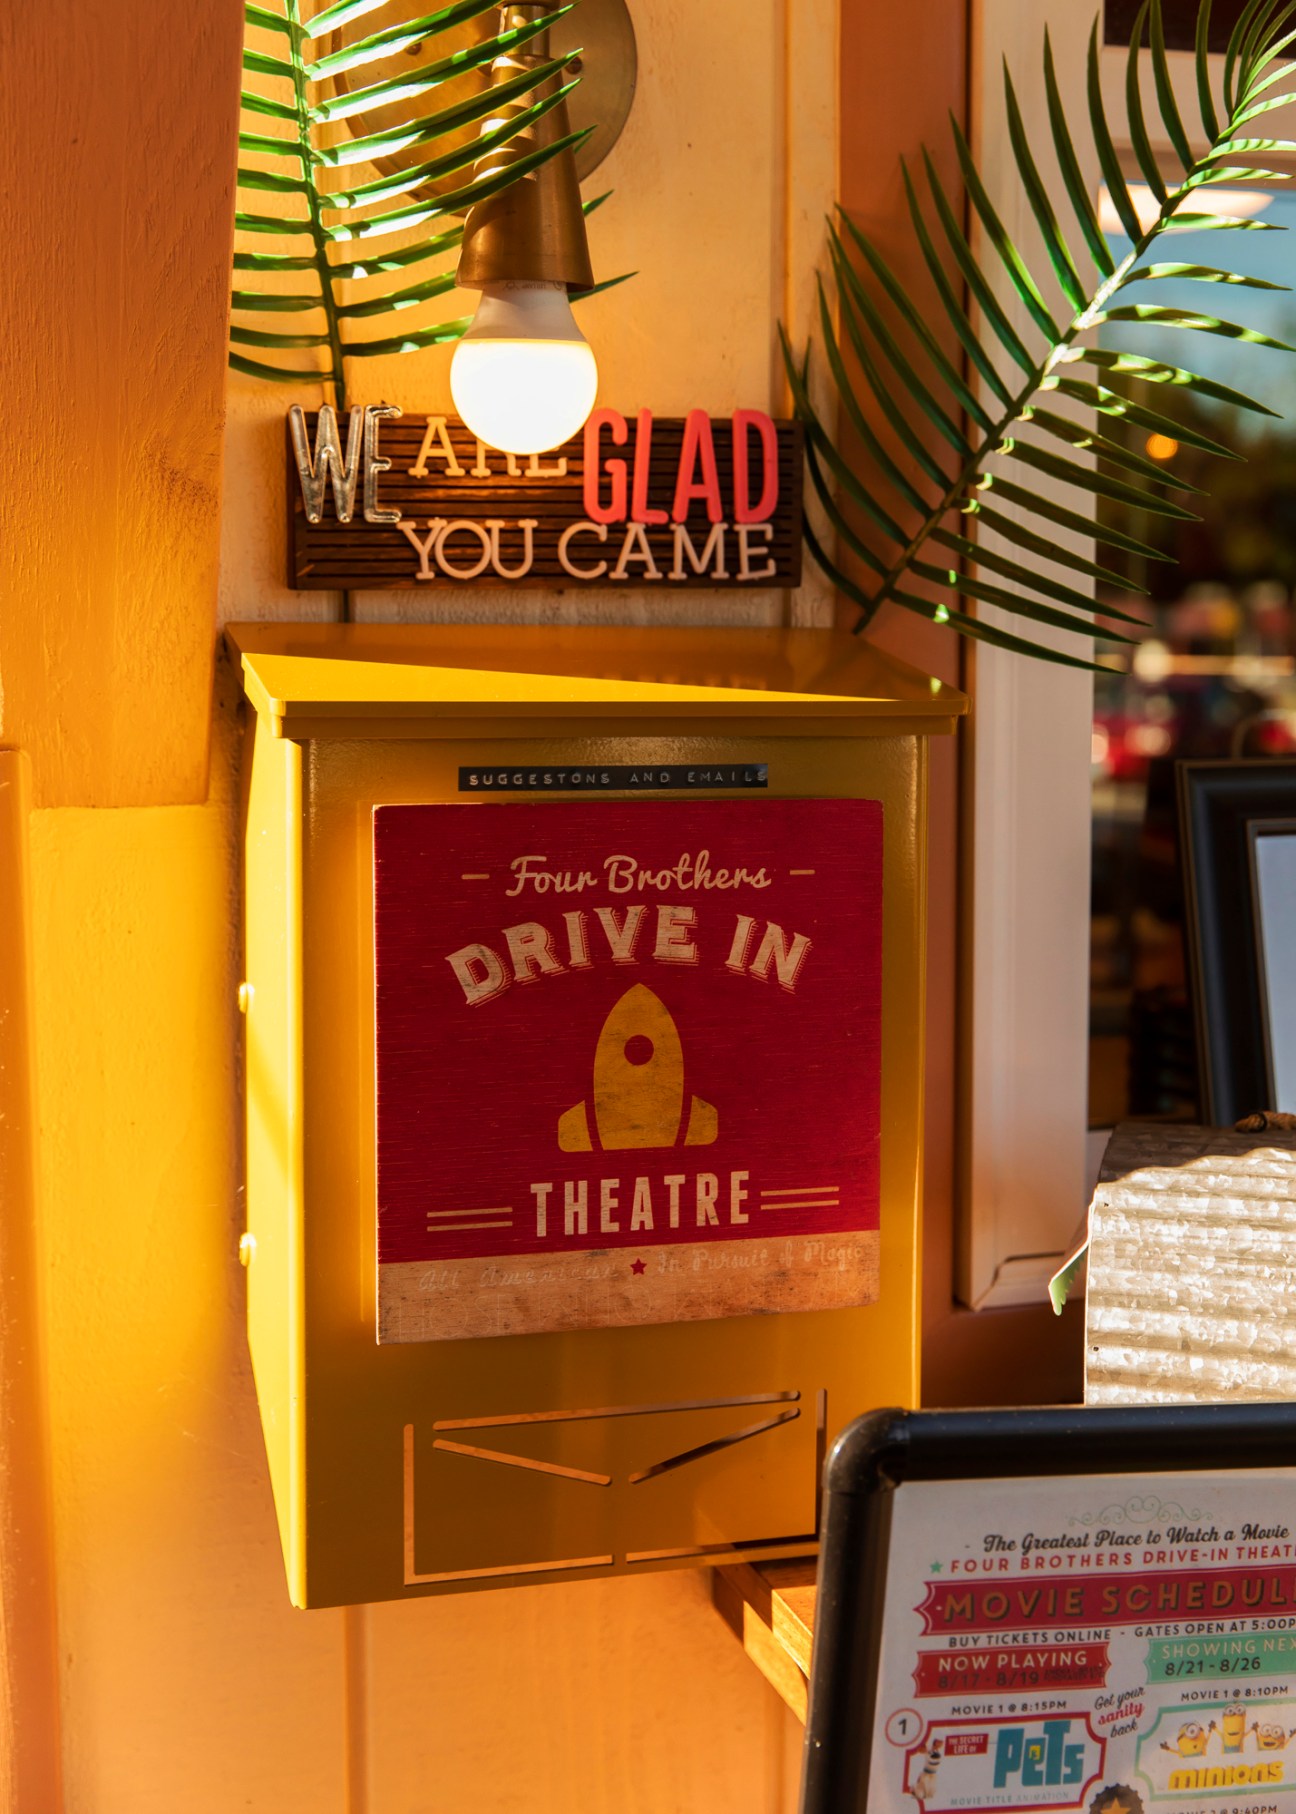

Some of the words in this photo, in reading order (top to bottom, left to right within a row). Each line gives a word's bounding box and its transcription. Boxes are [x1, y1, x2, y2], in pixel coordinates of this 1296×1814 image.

[289, 404, 402, 524] WE
[583, 408, 779, 524] GLAD
[399, 518, 539, 580] YOU
[557, 521, 776, 581] CAME
[469, 773, 610, 786] SUGGESTONS
[629, 772, 671, 784] AND
[687, 770, 768, 784] EMAILS
[504, 855, 597, 897] Four
[603, 850, 772, 894] Brothers
[445, 904, 700, 1007] DRIVE
[725, 914, 813, 994] IN
[530, 1171, 750, 1237] THEATRE
[983, 1534, 1016, 1553] The
[1021, 1532, 1090, 1556] Greatest
[1094, 1529, 1143, 1547] Place
[1146, 1529, 1161, 1544] to
[1166, 1526, 1221, 1544] Watch
[1224, 1530, 1235, 1541] a
[1241, 1523, 1290, 1541] Movie
[951, 1558, 1009, 1573] FOUR
[1020, 1552, 1133, 1570] BROTHERS
[1143, 1548, 1229, 1565] DRIVE-IN
[1236, 1544, 1296, 1560] THEAT
[944, 1587, 1085, 1623] MOVIE
[949, 1635, 980, 1648] BUY
[987, 1632, 1049, 1645] TICKETS
[1054, 1629, 1112, 1643] ONLINE
[1134, 1623, 1180, 1638] GATES
[1185, 1621, 1225, 1634] OPEN
[1229, 1620, 1247, 1632] AT
[938, 1655, 990, 1672] NOW
[997, 1651, 1088, 1669] PLAYING
[1162, 1640, 1256, 1660] SHOWING
[1164, 1660, 1204, 1676] 8/21
[1219, 1656, 1261, 1673] 8/26
[996, 1671, 1040, 1687] 8/19
[1094, 1696, 1115, 1710] Get
[1117, 1686, 1145, 1709] your
[1181, 1689, 1219, 1701] MOVIE
[1223, 1690, 1228, 1698] 1
[1232, 1688, 1241, 1697] @
[1245, 1686, 1288, 1697] 8:10PM
[951, 1704, 993, 1715] MOVIE
[998, 1704, 1003, 1713] 1
[1007, 1703, 1017, 1713] @
[1021, 1701, 1067, 1712] 8:15PM
[1098, 1702, 1145, 1725] sanity
[898, 1718, 907, 1736] 1
[1110, 1718, 1138, 1738] back
[959, 1735, 984, 1744] SECRET
[1168, 1760, 1284, 1791] minions
[951, 1797, 983, 1806] MOVIE
[986, 1794, 1012, 1804] TITLE
[1016, 1792, 1069, 1803] ANIMATION
